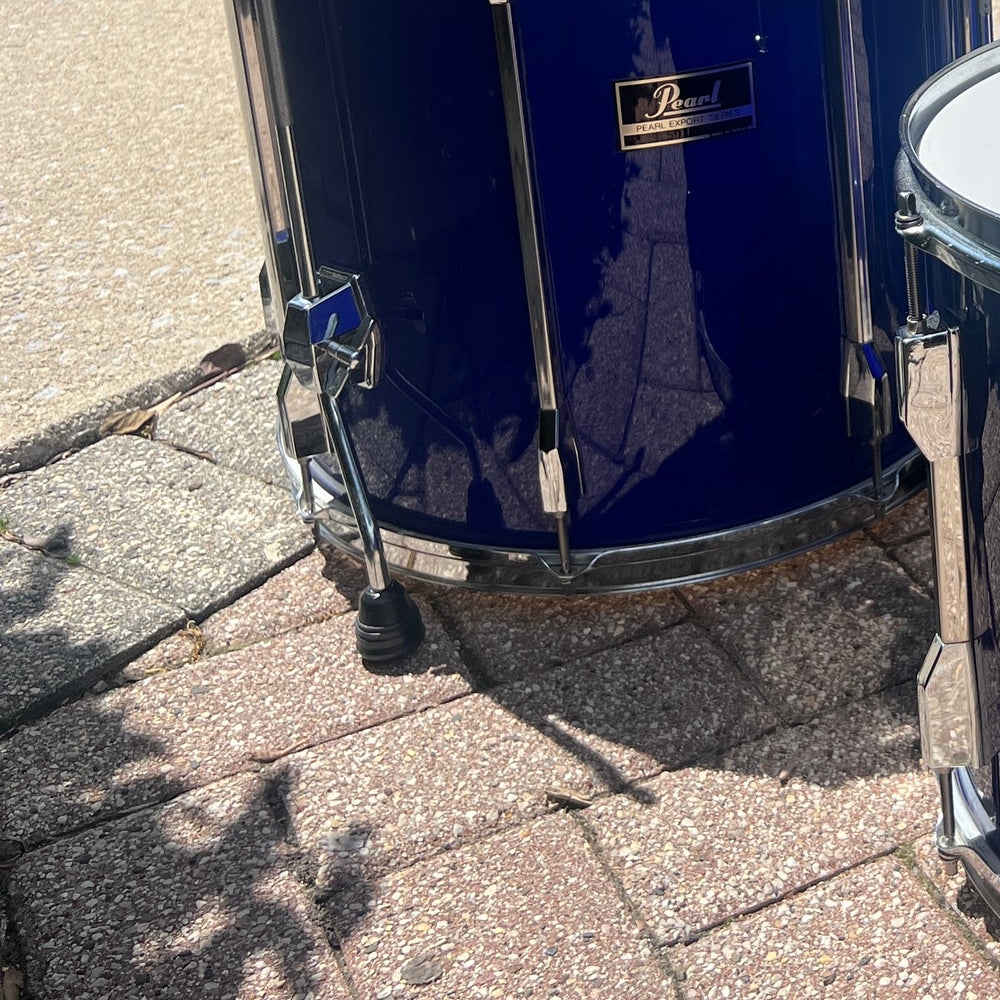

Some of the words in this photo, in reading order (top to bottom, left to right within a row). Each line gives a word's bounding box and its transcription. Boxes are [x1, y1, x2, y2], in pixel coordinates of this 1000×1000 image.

[645, 80, 721, 119] Pearl
[636, 123, 666, 132] PEARL
[669, 115, 705, 128] EXPORT
[709, 109, 740, 121] SERIES
